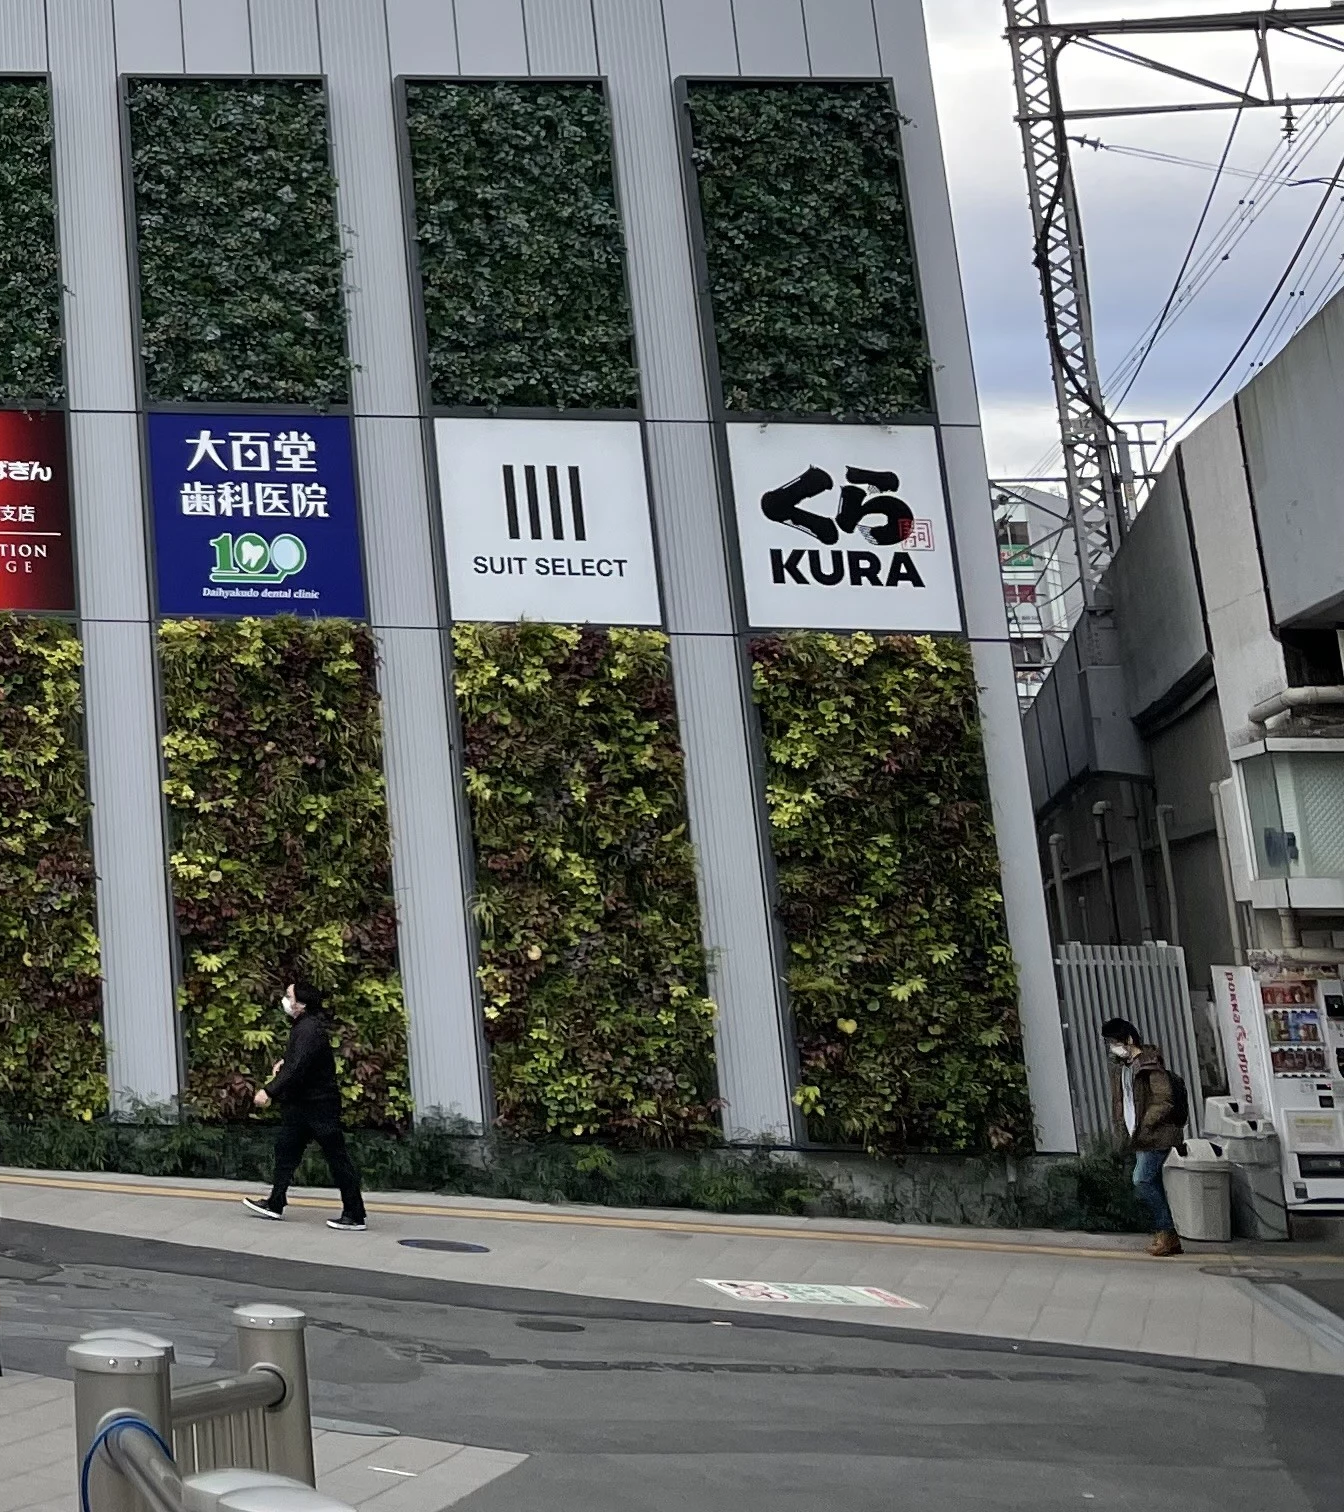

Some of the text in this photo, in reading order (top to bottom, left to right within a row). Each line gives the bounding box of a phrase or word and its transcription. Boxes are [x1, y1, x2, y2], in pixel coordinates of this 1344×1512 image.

[185, 430, 318, 473] 大百堂
[180, 482, 329, 518] 歯科医院
[760, 464, 915, 546] くら
[473, 556, 628, 578] SUIT SELECT
[770, 548, 926, 588] KURA
[202, 588, 320, 599] Daihyakudo dental clinic
